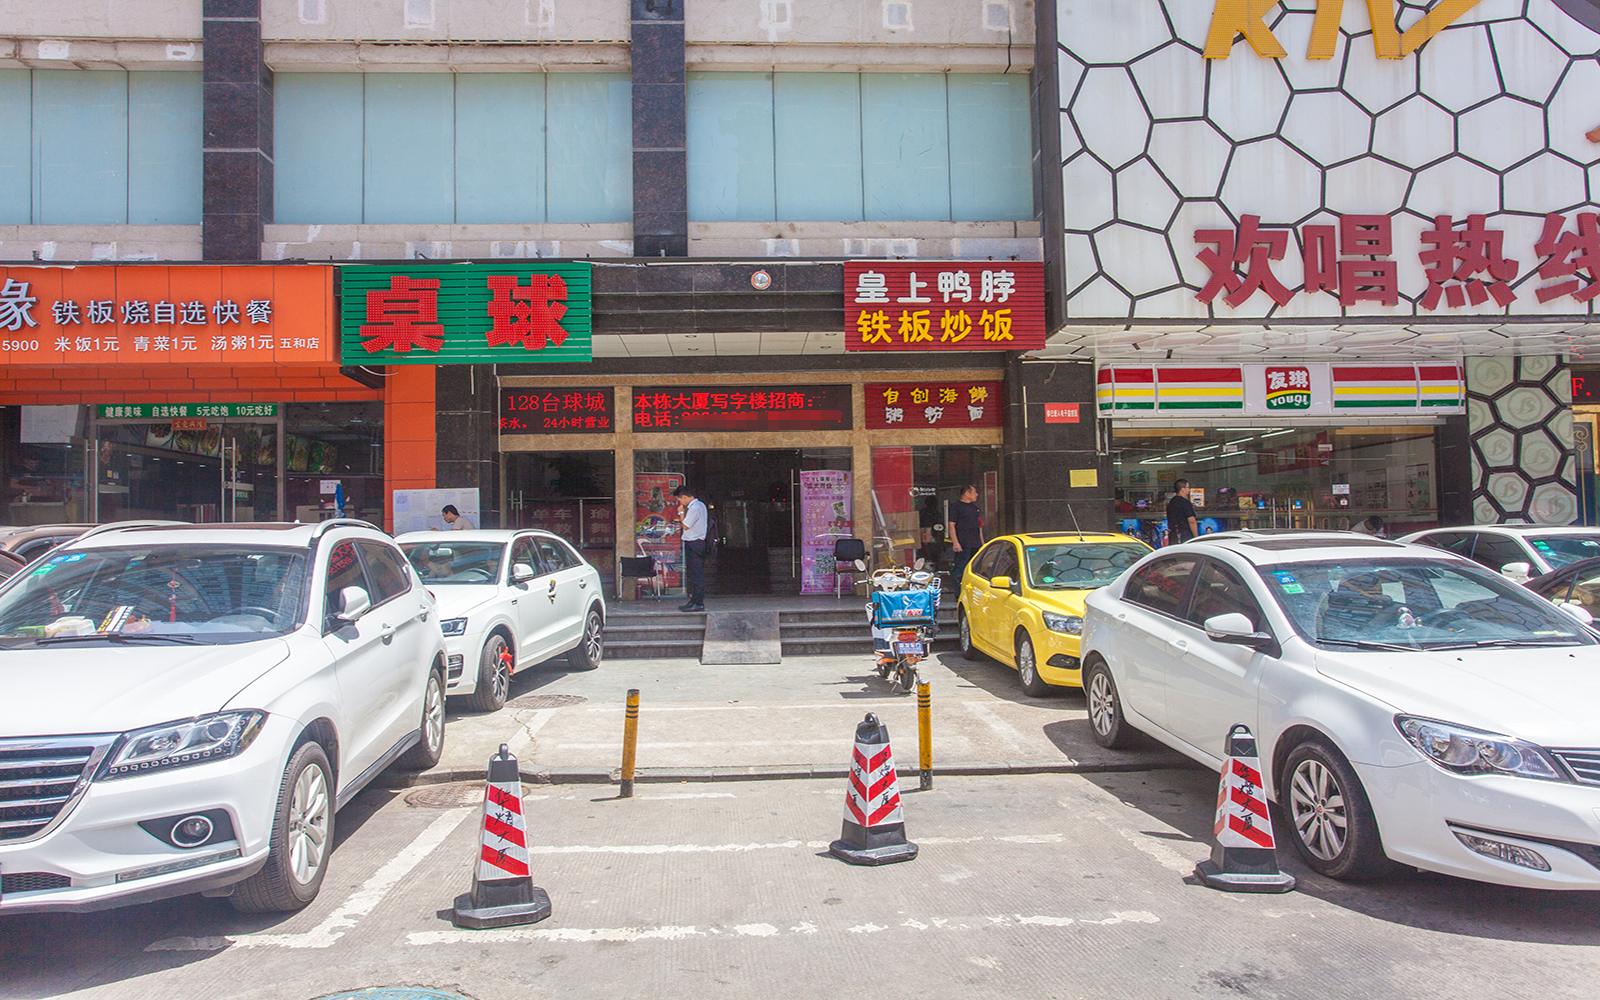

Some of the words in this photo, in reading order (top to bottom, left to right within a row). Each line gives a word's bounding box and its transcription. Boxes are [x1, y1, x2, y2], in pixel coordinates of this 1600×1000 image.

[1194, 213, 1600, 311] 欢唱热线
[854, 270, 1016, 303] 皇上鸭脖
[52, 300, 274, 327] 铁板烧自选快餐
[360, 274, 569, 354] 桌球
[857, 309, 1014, 343] 铁板炒饭
[1, 339, 39, 351] 5900
[54, 336, 120, 352] 米饭1元
[133, 336, 197, 352] 青菜1元
[211, 334, 274, 351] 汤粥1元
[279, 337, 320, 351] 五和店
[1267, 370, 1309, 390] 友琪
[508, 392, 606, 412] 128台球城
[883, 386, 989, 405] 自创海鲜
[105, 406, 142, 418] 健康美味
[152, 406, 188, 417] 自选快餐
[197, 405, 229, 417] 5元吃饱
[236, 405, 273, 416] 10元吃好
[885, 405, 984, 424] 粥粉面
[543, 416, 610, 429] 24小时营业
